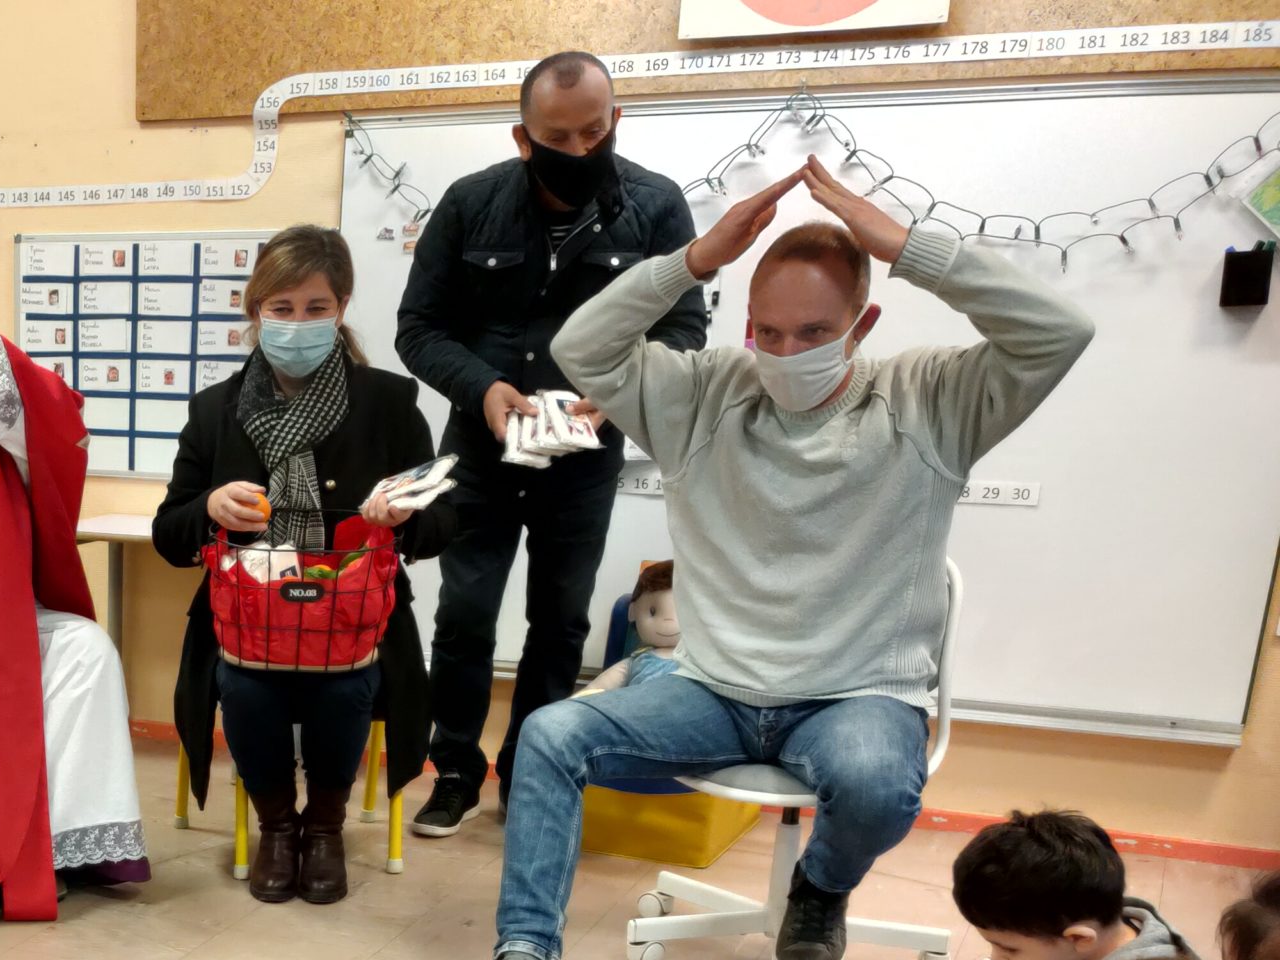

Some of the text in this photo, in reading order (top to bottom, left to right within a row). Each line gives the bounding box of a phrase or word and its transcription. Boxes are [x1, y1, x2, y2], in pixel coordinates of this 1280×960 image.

[612, 29, 1272, 73] 168 169 170 171 172 173 174 175 176 177 178 179 180 181 182 183 184 185
[400, 73, 419, 85] 161
[430, 72, 450, 83] 162
[456, 70, 476, 82] 163
[484, 69, 505, 80] 164
[319, 78, 338, 89] 158
[347, 77, 366, 88] 159
[370, 75, 390, 86] 160
[290, 83, 309, 94] 157
[260, 98, 279, 108] 156
[258, 119, 277, 130] 155
[257, 141, 275, 151] 154
[254, 163, 272, 173] 153
[58, 190, 75, 201] 145
[82, 189, 100, 201] 146
[107, 188, 124, 199] 147
[131, 187, 148, 199] 148
[157, 186, 174, 198] 149
[183, 185, 201, 196] 150
[206, 186, 224, 197] 151
[231, 184, 249, 196] 152
[12, 192, 28, 203] 143
[34, 191, 50, 202] 144
[618, 478, 661, 490] 5 16 1
[961, 487, 1030, 500] 8 29 30
